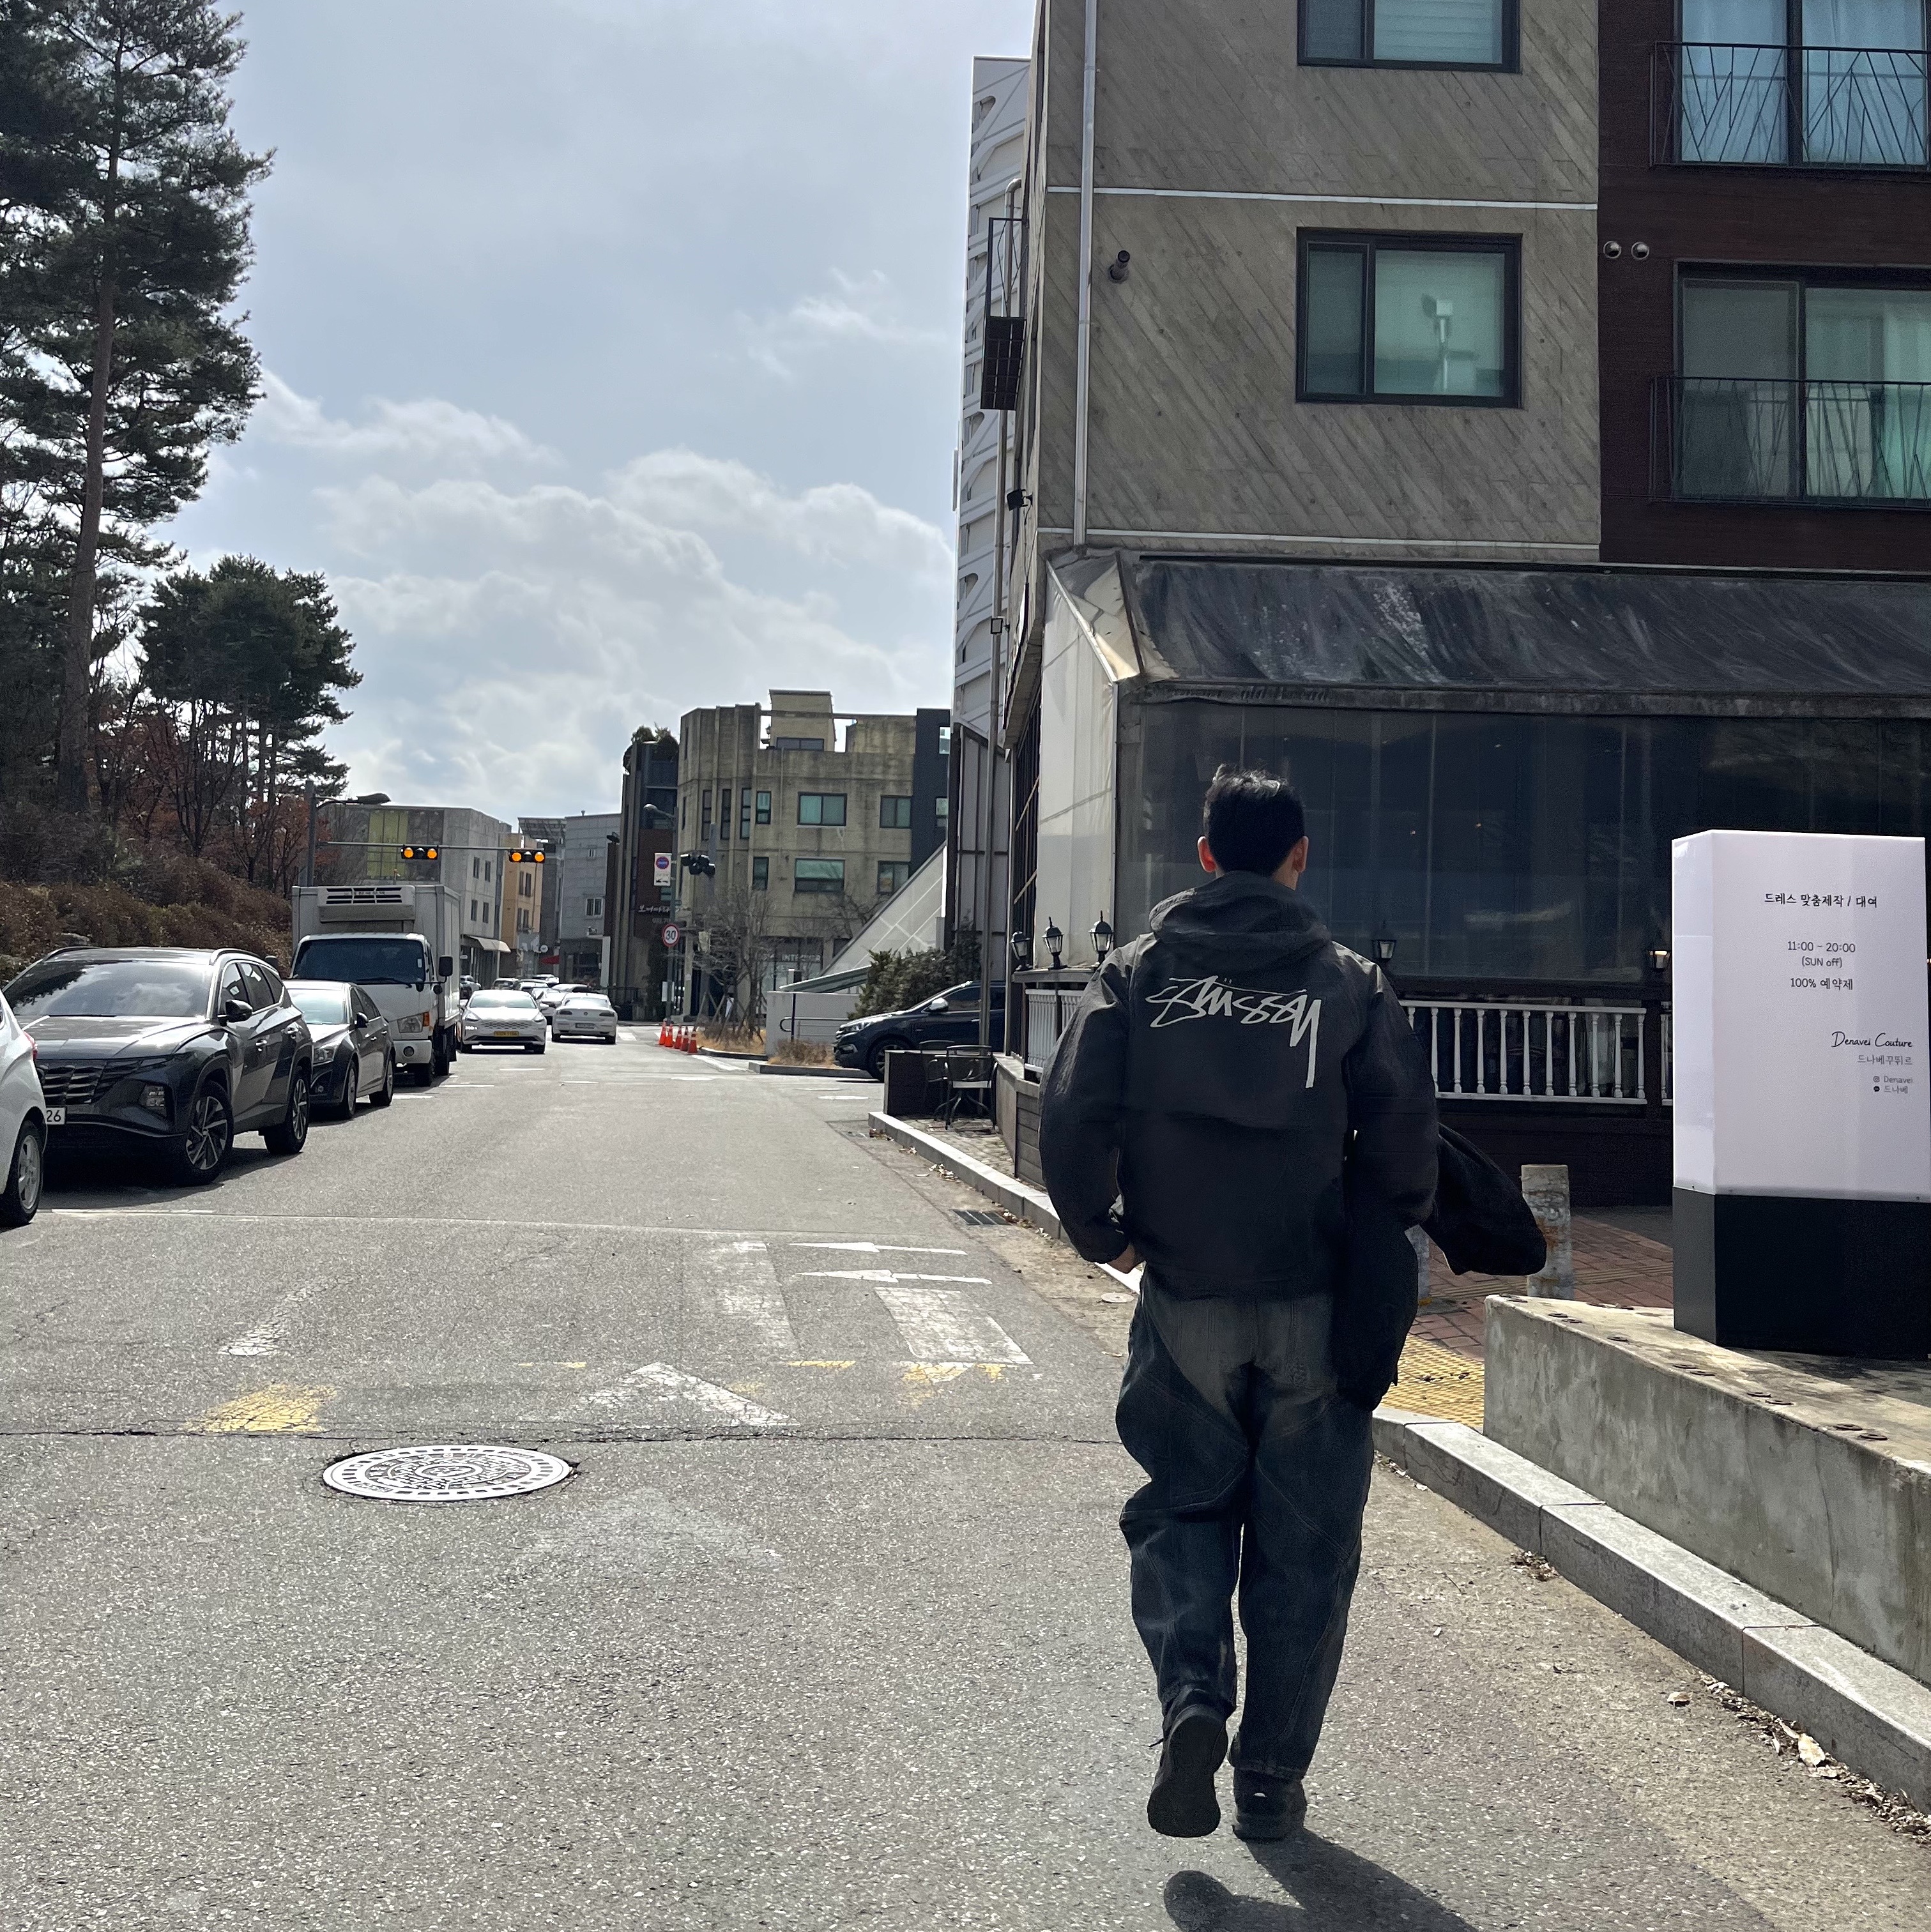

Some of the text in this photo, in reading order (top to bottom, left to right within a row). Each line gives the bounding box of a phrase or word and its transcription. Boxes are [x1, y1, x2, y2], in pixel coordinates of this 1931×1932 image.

[1764, 893, 1878, 908] 드레스 맞춤제작 / 대여
[666, 930, 676, 941] 30
[1787, 941, 1814, 951] 11:00
[1826, 943, 1856, 953] 20:00
[1801, 955, 1843, 968] (SUN off)
[1790, 978, 1853, 991] 100% 예약제
[1831, 1031, 1913, 1047] Denavei Couture
[1857, 1054, 1913, 1065] 드나베꾸뛰르
[1883, 1076, 1913, 1084] Denavei
[1883, 1085, 1908, 1095] 드나베
